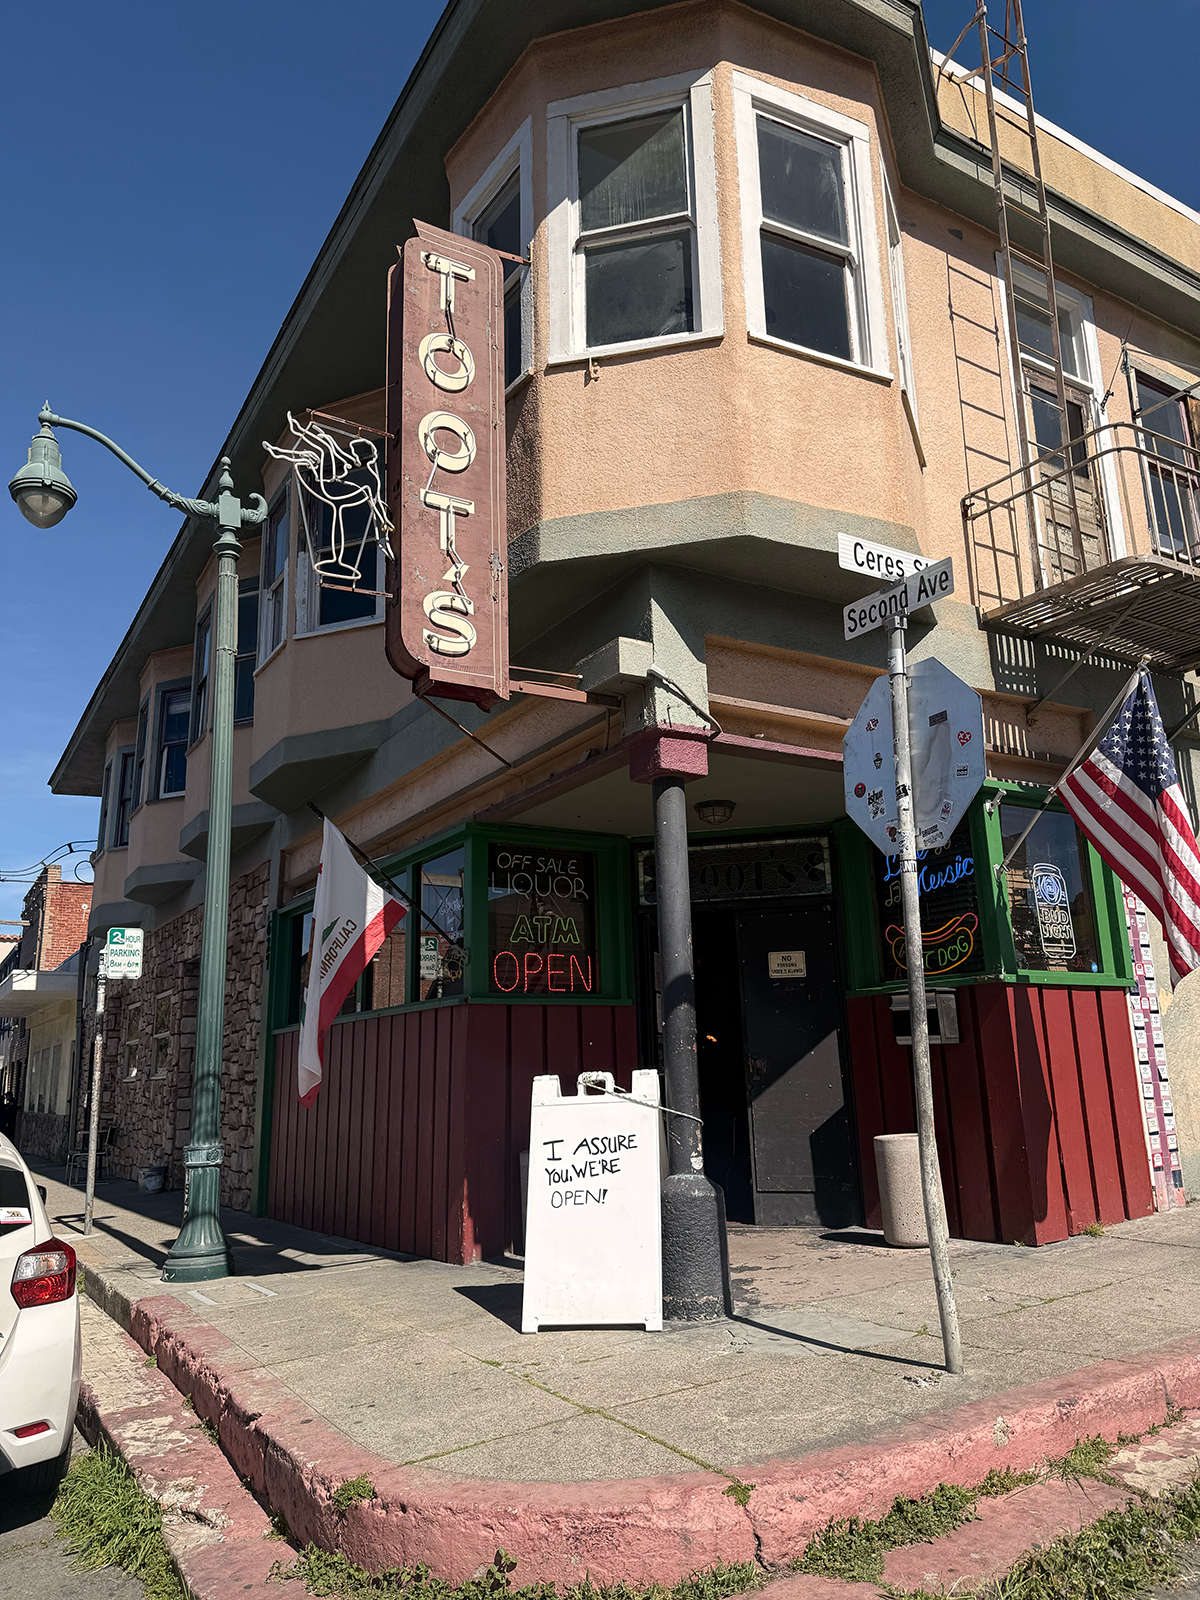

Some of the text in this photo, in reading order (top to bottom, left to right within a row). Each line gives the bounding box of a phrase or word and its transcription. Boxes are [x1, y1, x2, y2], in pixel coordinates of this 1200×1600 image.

[418, 250, 477, 657] TOOT'S
[854, 542, 928, 577] Ceres S
[848, 570, 949, 633] Second Ave
[497, 852, 578, 875] OFF SALE
[688, 848, 797, 894] OOT'S
[491, 871, 588, 900] LIQUOR
[510, 915, 580, 944] ATM
[1041, 909, 1069, 924] BUD
[112, 931, 141, 944] 2 HOUR
[938, 935, 968, 967] DOG
[110, 949, 140, 957] PARKING
[494, 951, 591, 992] OPEN
[543, 1134, 638, 1161] I ASSURE
[551, 1188, 608, 1208] OPEN!
